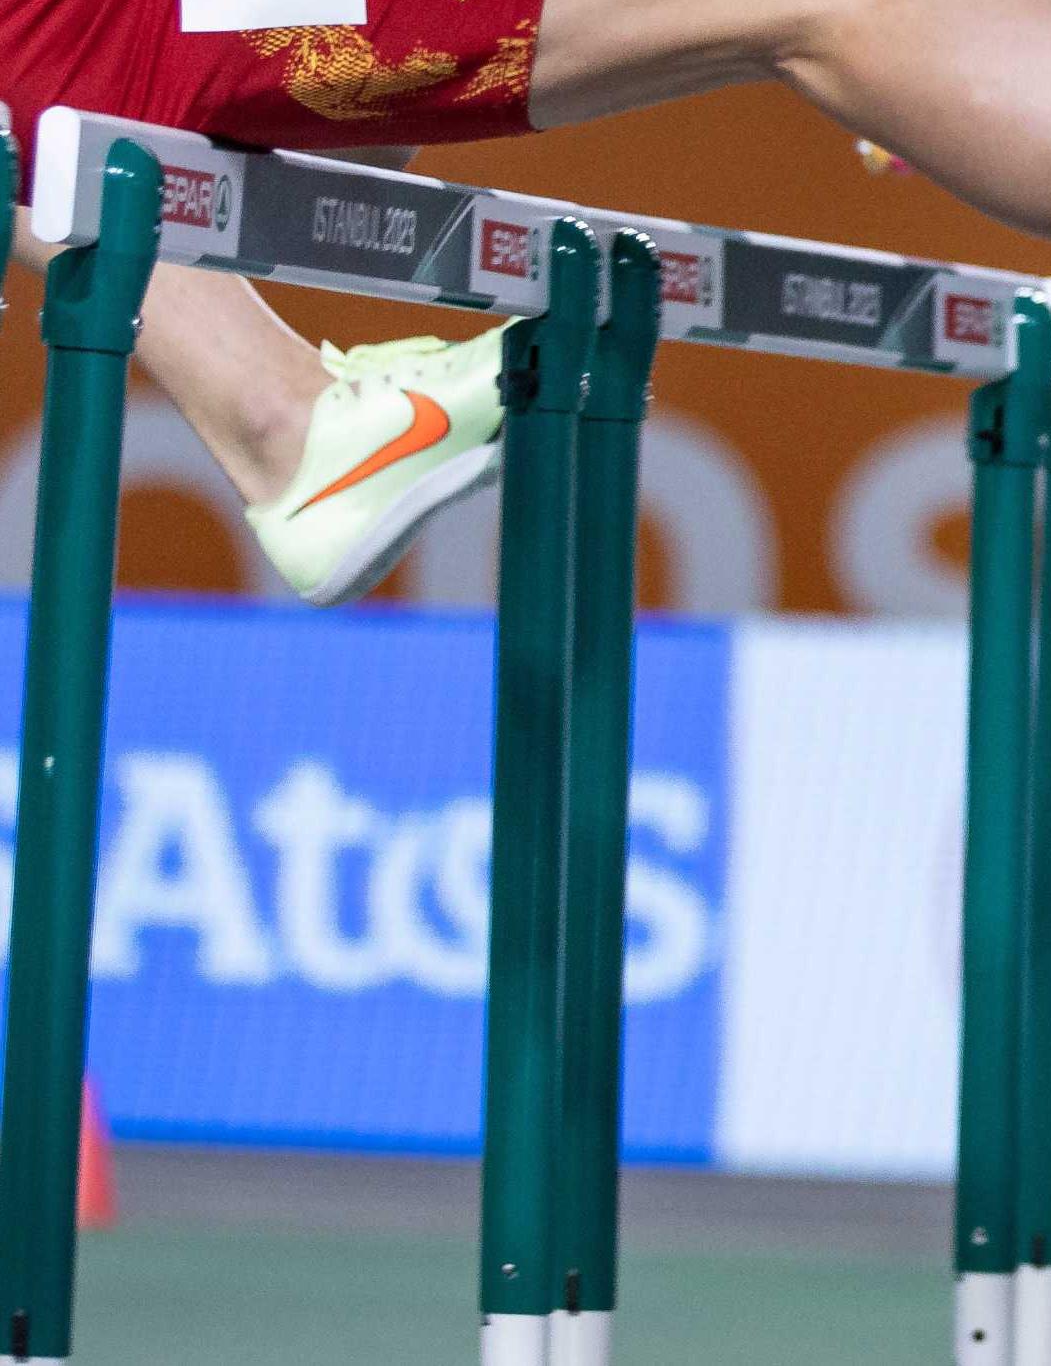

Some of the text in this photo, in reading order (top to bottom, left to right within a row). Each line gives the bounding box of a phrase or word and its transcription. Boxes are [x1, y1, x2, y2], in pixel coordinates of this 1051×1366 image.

[163, 173, 214, 220] SPAR
[311, 196, 417, 255] ISTANBUL 2023
